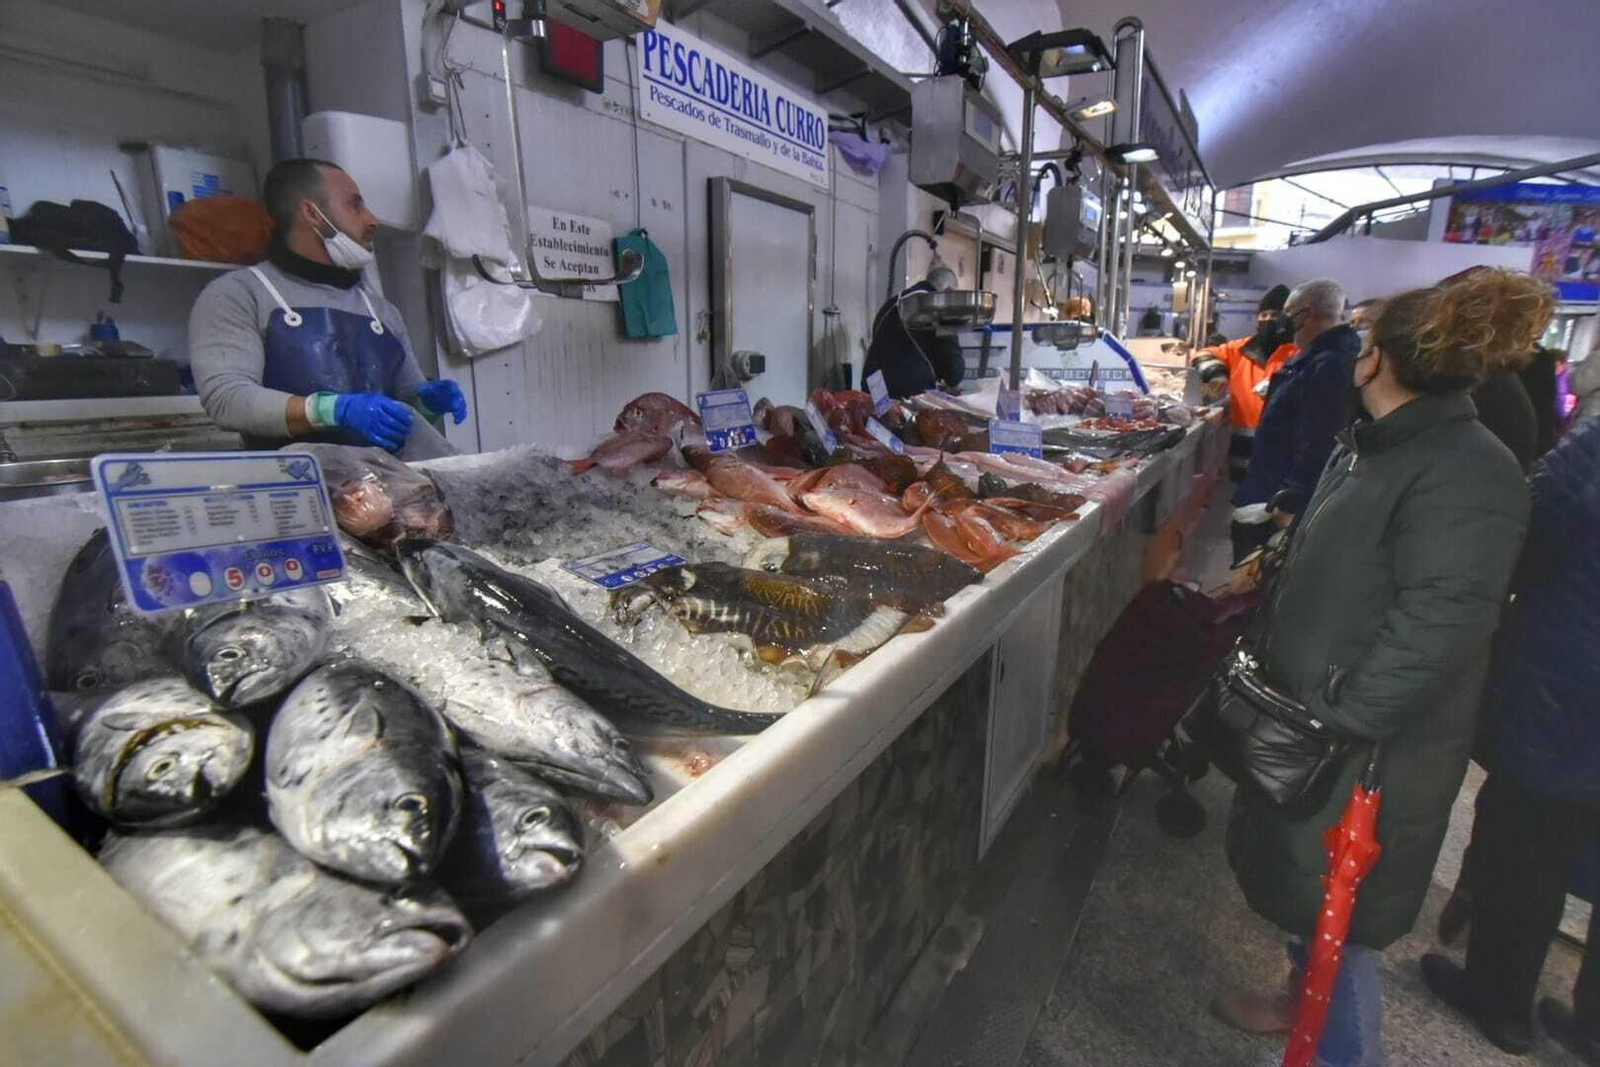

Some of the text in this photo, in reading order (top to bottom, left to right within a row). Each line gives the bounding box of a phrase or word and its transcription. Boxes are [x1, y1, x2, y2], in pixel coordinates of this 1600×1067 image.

[643, 30, 826, 151] PESCADERIA CURRO
[649, 85, 706, 122] Pescados
[708, 111, 721, 129] de
[724, 117, 772, 150] Trasmallo
[772, 141, 779, 156] y
[552, 216, 591, 236] En Este
[529, 233, 609, 257] Establecimiento
[543, 256, 600, 276] Se Aceptan
[227, 568, 242, 588] 5
